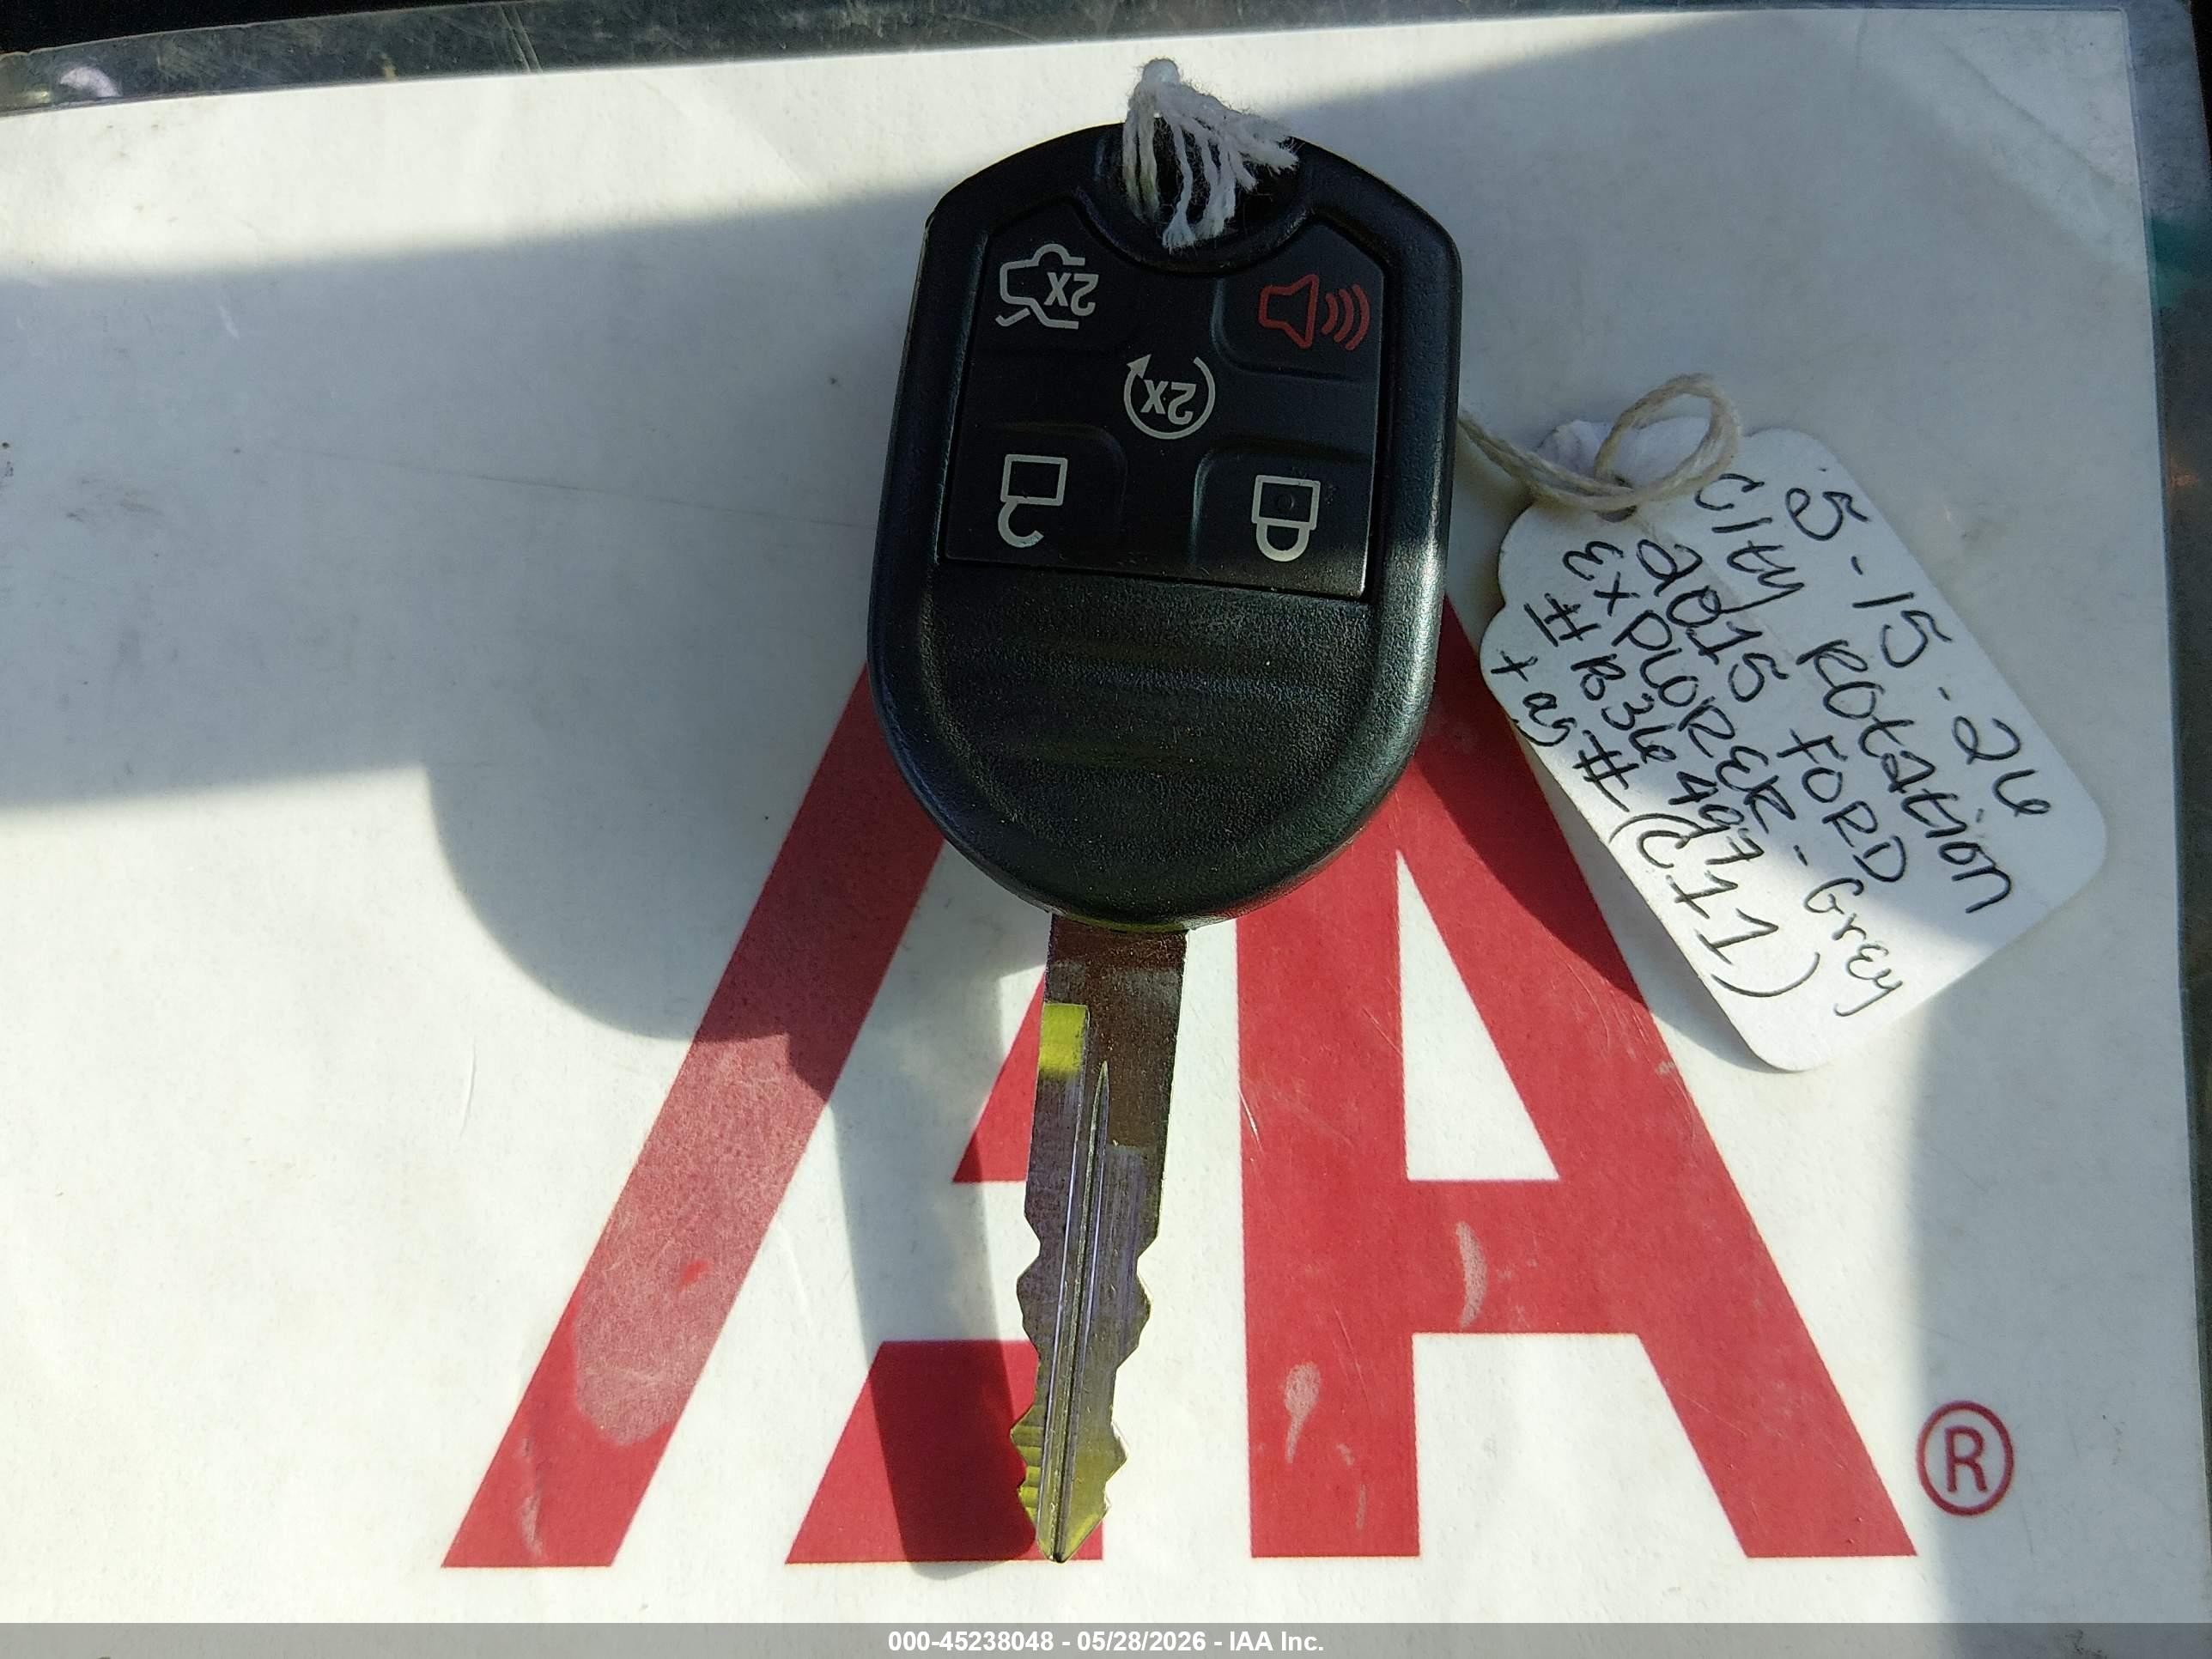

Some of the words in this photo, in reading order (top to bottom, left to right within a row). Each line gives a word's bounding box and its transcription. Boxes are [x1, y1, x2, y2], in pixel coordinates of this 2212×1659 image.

[1043, 271, 1099, 316] 2X
[1140, 379, 1197, 425] 2X
[1635, 538, 1790, 704] 2015
[1776, 728, 1910, 884] FORD
